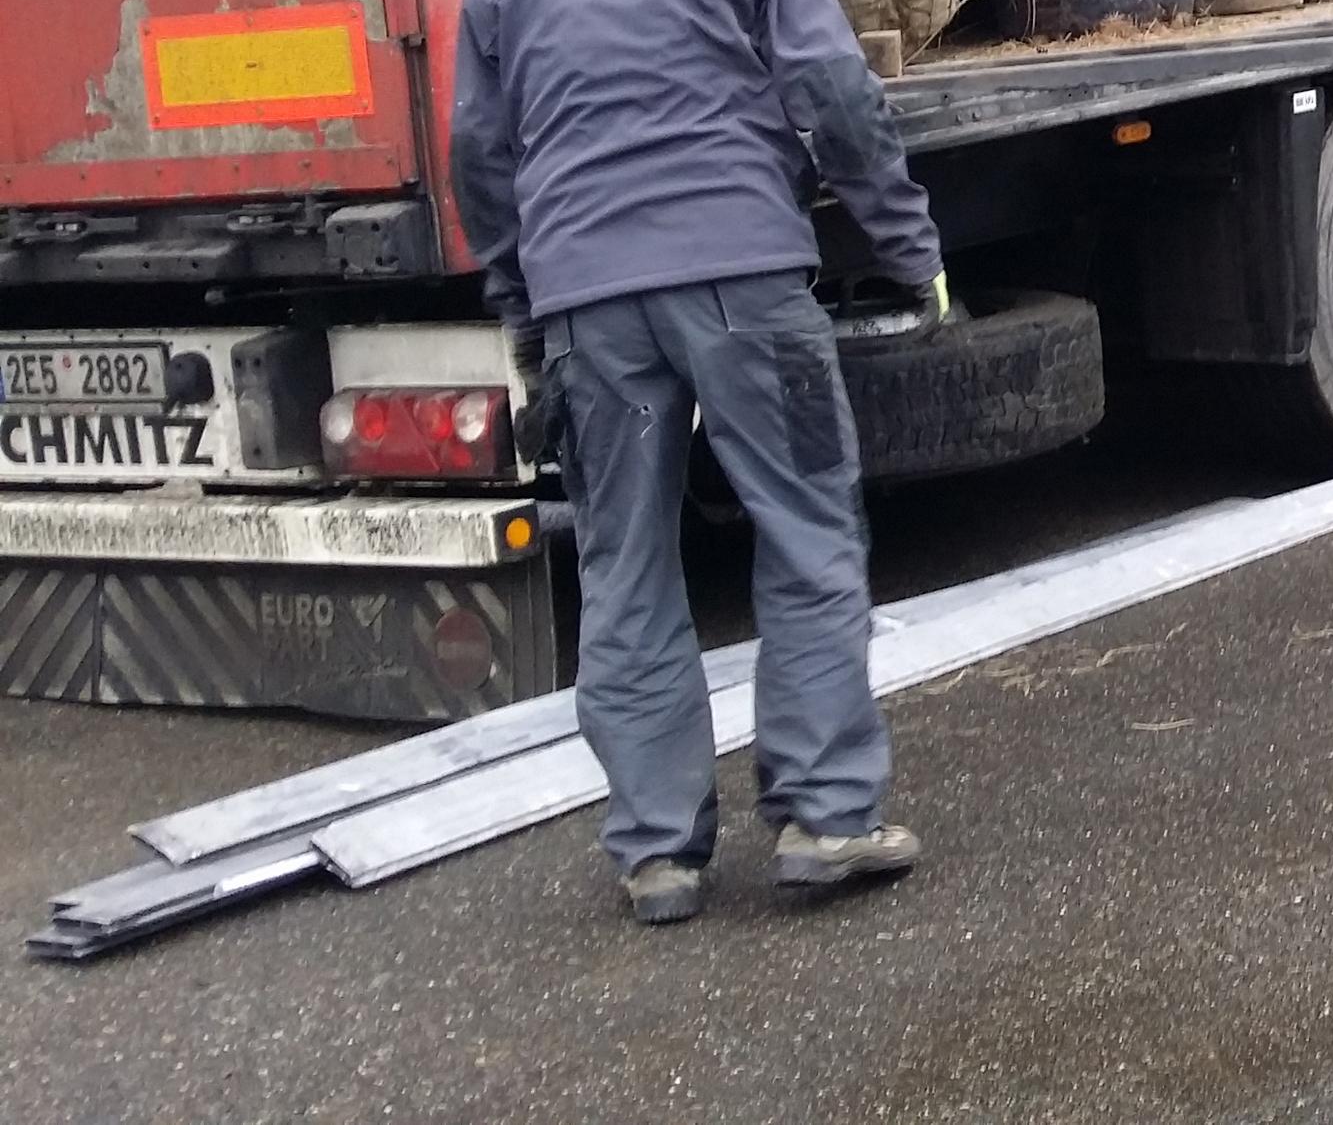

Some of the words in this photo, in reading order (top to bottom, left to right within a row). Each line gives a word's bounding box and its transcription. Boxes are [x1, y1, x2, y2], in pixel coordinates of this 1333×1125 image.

[78, 353, 151, 395] 2882
[0, 415, 214, 465] CHMITZ
[260, 592, 335, 627] EURO
